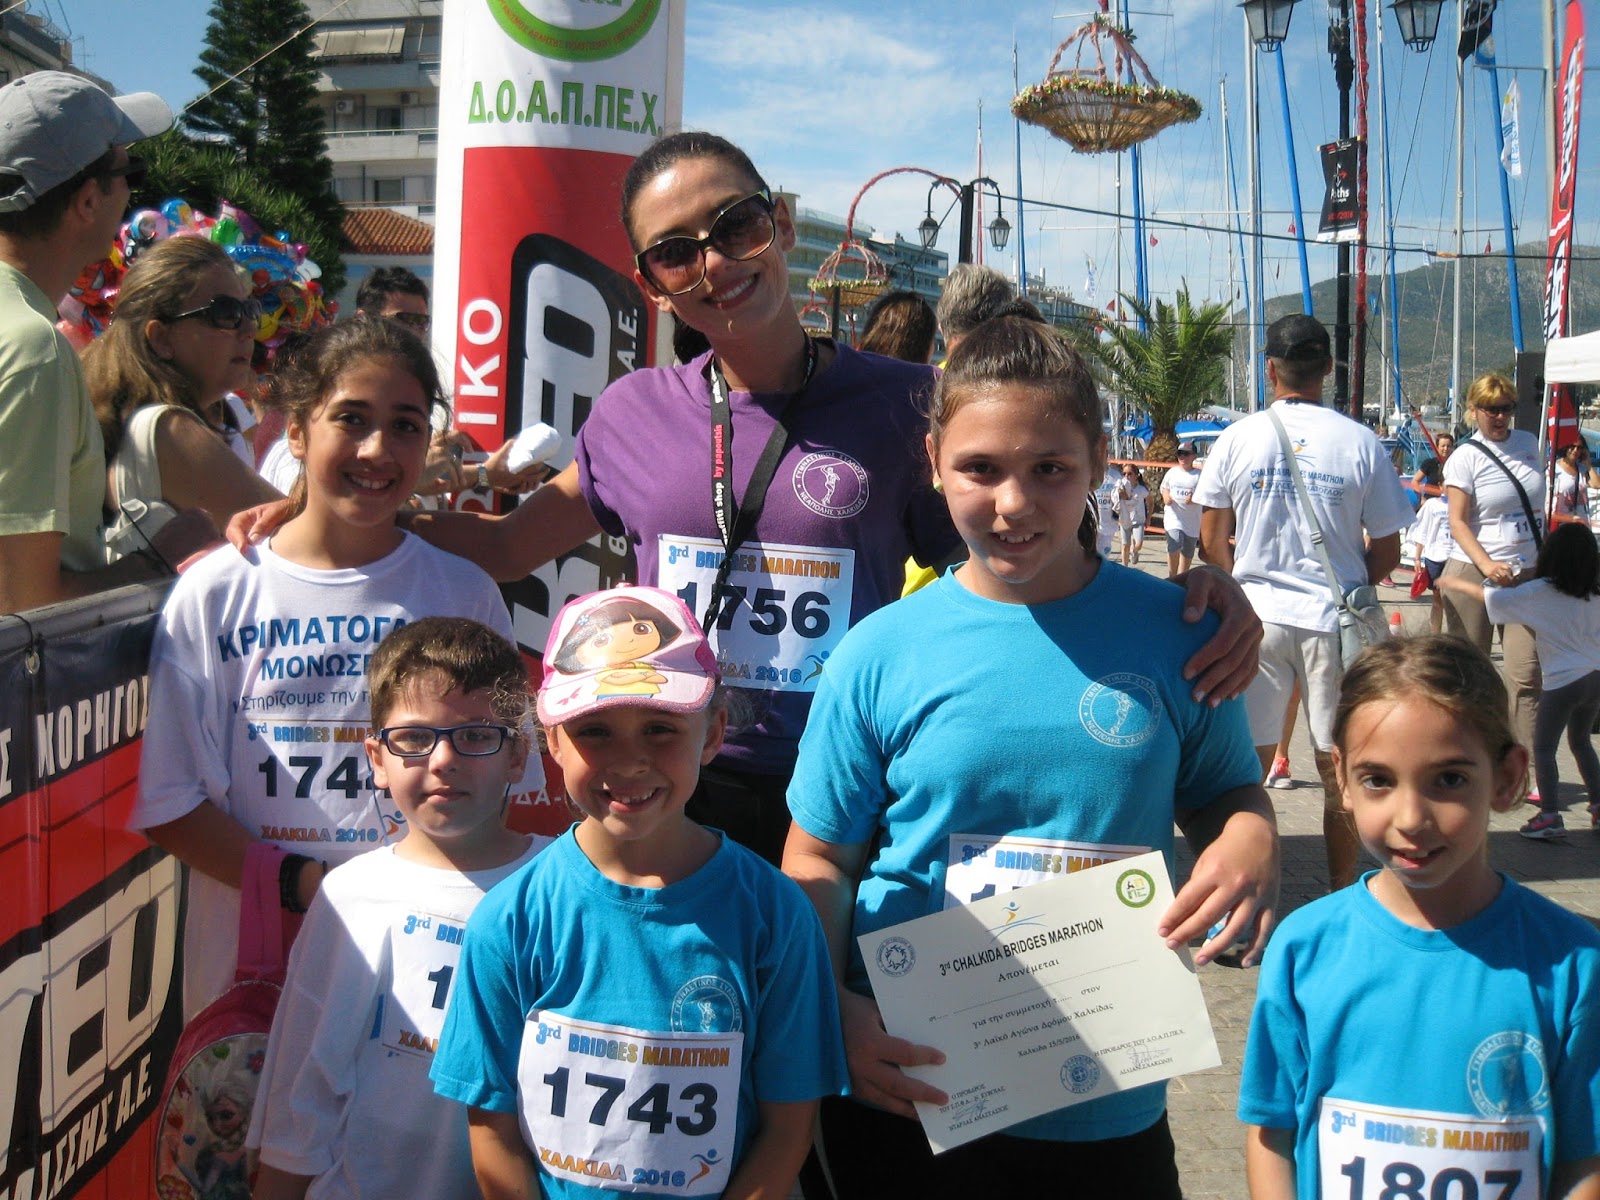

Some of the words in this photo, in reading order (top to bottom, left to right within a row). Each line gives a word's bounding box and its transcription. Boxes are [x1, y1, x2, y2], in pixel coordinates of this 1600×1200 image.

[713, 424, 725, 465] papoutsis
[713, 466, 725, 479] by
[1308, 471, 1345, 486] MARATHON
[713, 482, 725, 508] shop
[800, 491, 835, 516] ΝΕΑΠΟΛΗΣ
[668, 545, 689, 565] 3rd
[760, 556, 841, 580] MARATHON
[677, 581, 831, 640] 1756
[755, 665, 802, 684] 2016
[247, 722, 268, 742] 3rd
[274, 726, 331, 743] BRIDGES
[261, 825, 332, 842] ΧΑΛΚΙΔΑ
[336, 827, 379, 843] 2016
[961, 844, 988, 867] 3rd
[995, 850, 1063, 874] BRIDGES
[403, 914, 432, 935] 3rd
[939, 961, 952, 977] 3rd
[952, 947, 1003, 972] CHALKIDA
[1003, 933, 1048, 959] BRIDGES
[1048, 917, 1104, 945] MARATHON
[998, 959, 1060, 983] Απονέμεται
[971, 1018, 987, 1030] για
[987, 1014, 1004, 1026] την
[1081, 985, 1102, 996] στον
[1010, 1026, 1040, 1041] Αγώνα
[1041, 1015, 1074, 1031] Δρόμου
[1073, 1003, 1115, 1020] Χαλκίδας
[535, 1022, 562, 1045] 3rd
[568, 1033, 639, 1063] BRIDGES
[642, 1045, 731, 1067] MARATHON
[543, 1066, 718, 1137] 1743
[1331, 1110, 1357, 1134] 3rd
[1364, 1119, 1438, 1149] BRIDGES
[1443, 1129, 1531, 1152] MARATHON
[538, 1146, 627, 1182] ΧΑΛΚΙΔΑ
[632, 1168, 686, 1187] 2016
[1341, 1155, 1523, 1200] 1807
